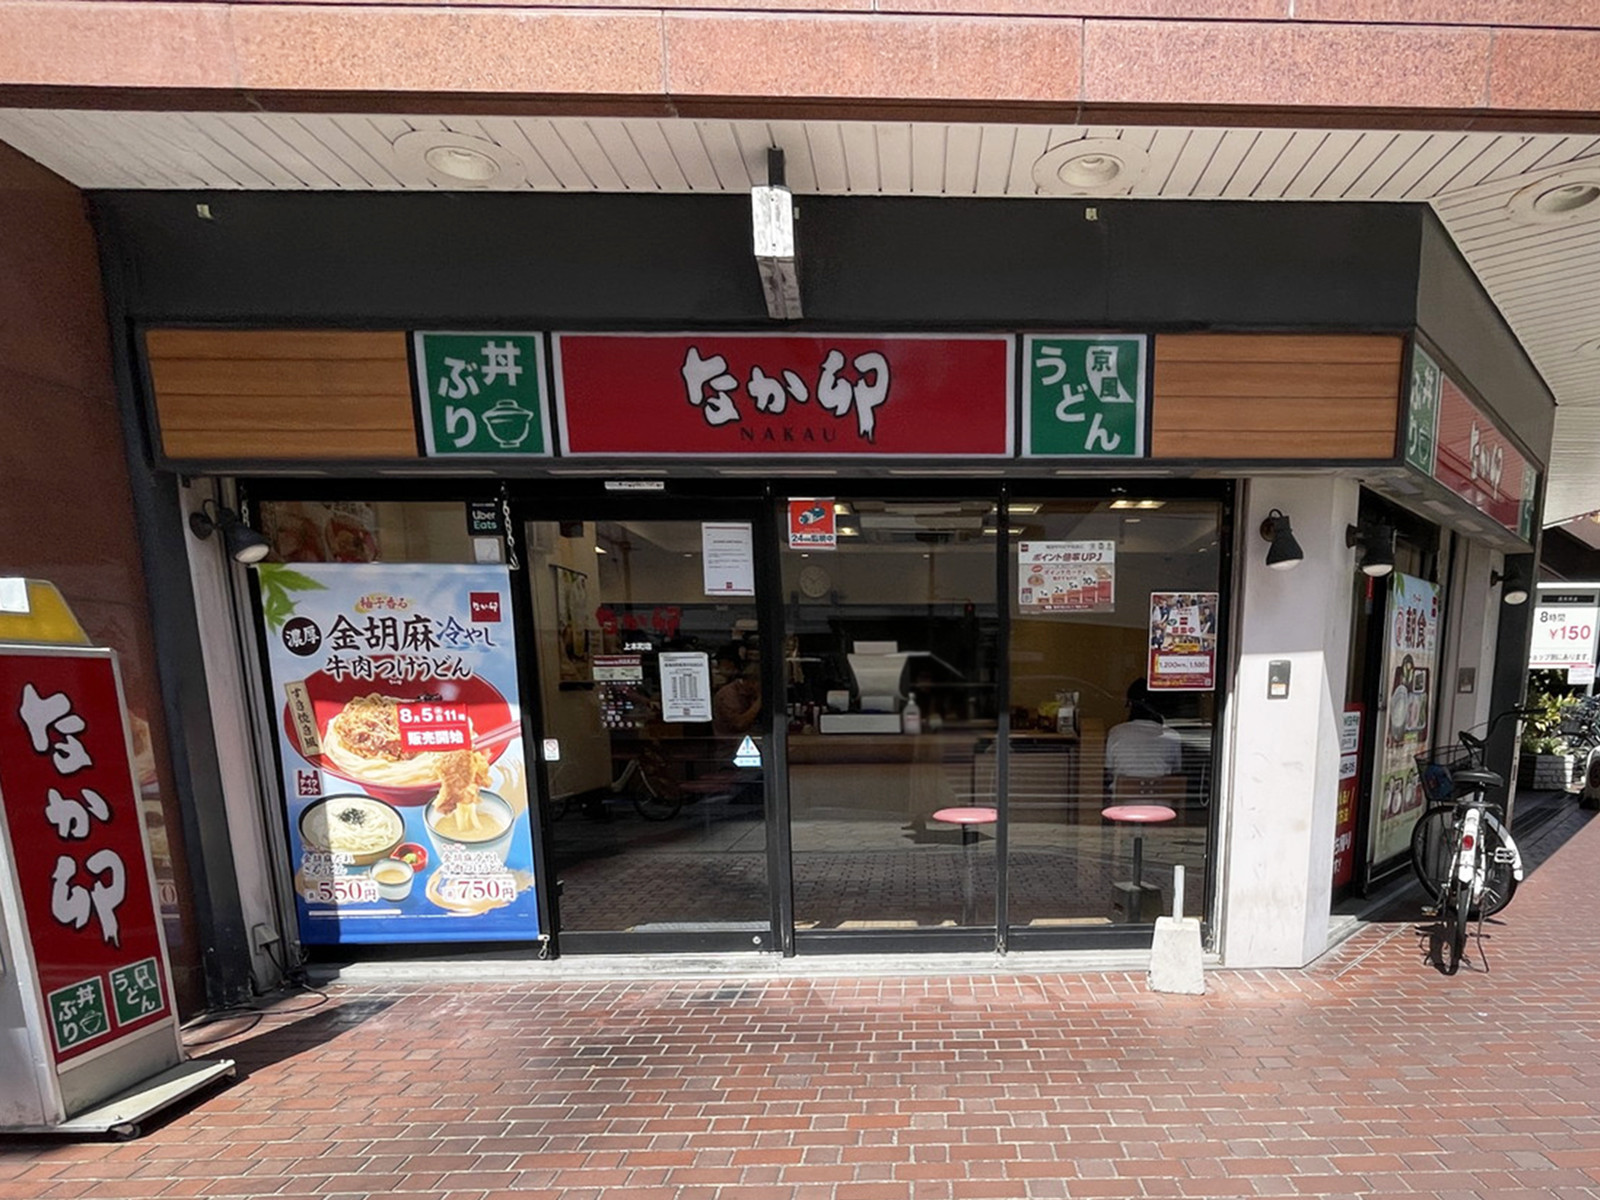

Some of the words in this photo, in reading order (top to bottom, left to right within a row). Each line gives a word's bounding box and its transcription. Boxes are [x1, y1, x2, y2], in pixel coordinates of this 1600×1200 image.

[681, 346, 891, 441] なか卯
[1034, 347, 1120, 452] うどん
[740, 426, 838, 442] NAKAU
[472, 510, 496, 520] Uber
[473, 521, 497, 530] Eats
[284, 629, 322, 649] 濃厚
[1549, 625, 1591, 640] ¥150
[325, 655, 472, 681] 牛肉つけうどん
[19, 683, 127, 947] なか卯
[115, 973, 156, 1013] うどん
